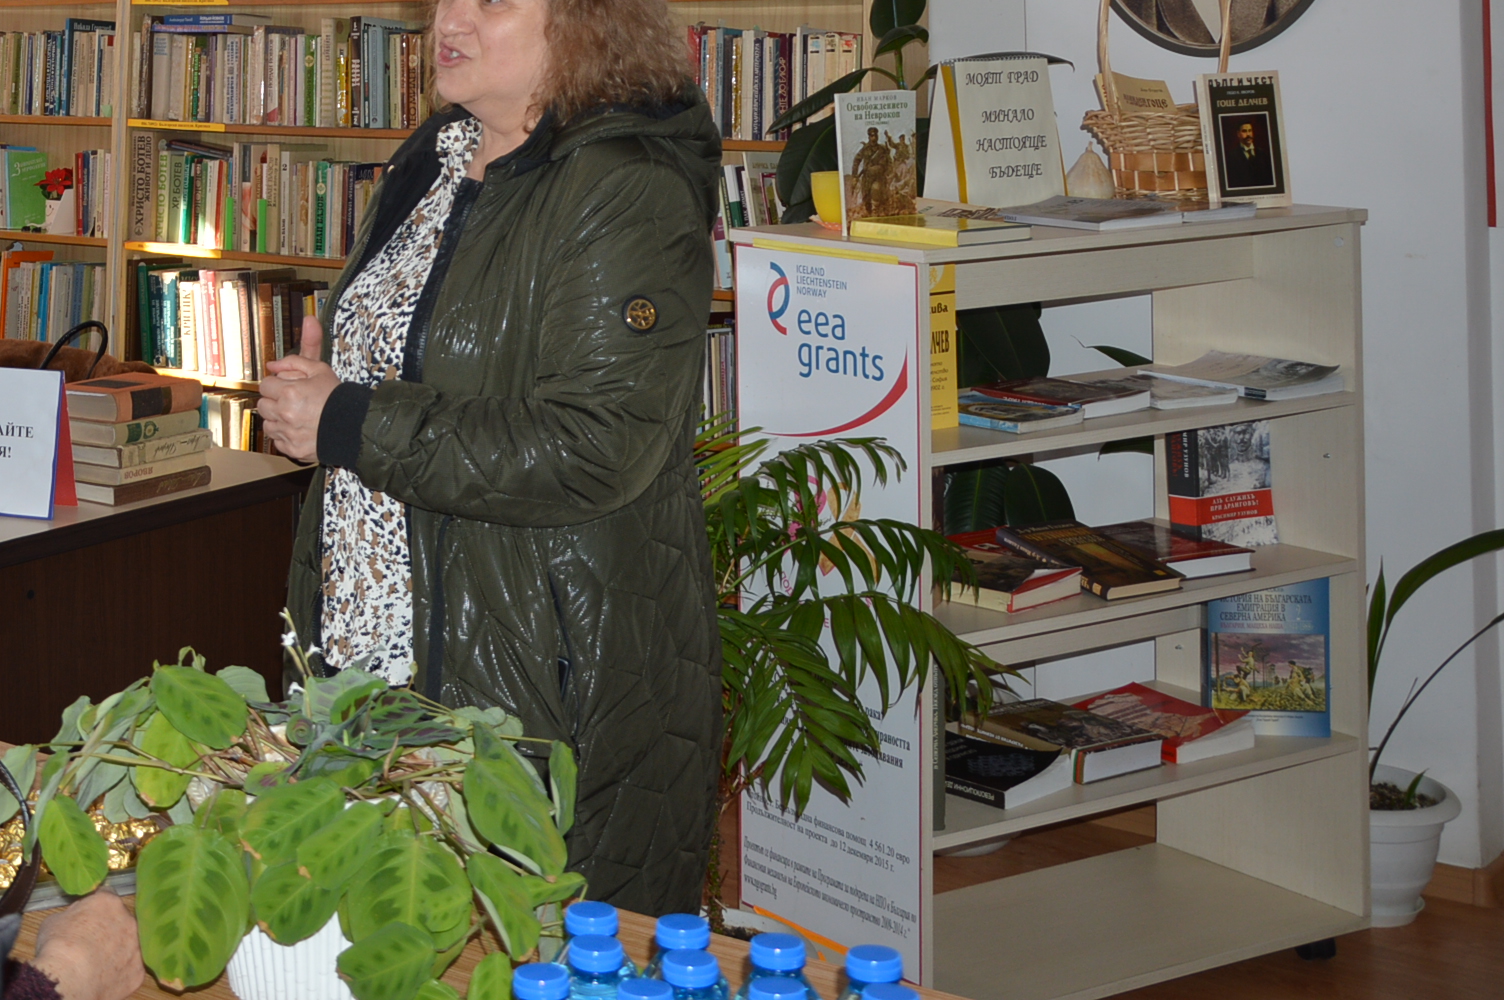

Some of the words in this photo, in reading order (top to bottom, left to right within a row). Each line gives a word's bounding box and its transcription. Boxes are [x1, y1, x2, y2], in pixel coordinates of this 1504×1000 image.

[965, 71, 1004, 87] МОЯТ
[1007, 70, 1039, 85] ГРАД
[1237, 77, 1244, 87] И
[846, 101, 908, 112] Освобождението
[1216, 99, 1236, 108] ГОЦЕ
[1238, 97, 1269, 107] ДЕЛЧЕВ
[864, 110, 901, 121] Неврокоп
[981, 108, 1035, 123] МИНАЛО
[976, 135, 1047, 153] НАСТОЯЩЕ
[136, 135, 146, 174] БОТЕВ
[158, 154, 167, 191] БОТЕВ
[172, 162, 182, 194] БОТЕВ
[988, 163, 1043, 179] БЪДЕЩЕ
[135, 177, 145, 227] ХРИСТО
[156, 193, 165, 238] ХРИСТО
[796, 264, 825, 277] ICELAND
[796, 275, 848, 290] LIECHTENSTEIN
[796, 286, 828, 298] NORWAY
[182, 289, 191, 336] КРИТИК
[930, 302, 949, 314] ива
[797, 308, 846, 341] eea
[930, 330, 950, 355] ЛЧЕВ
[797, 342, 885, 382] grants
[124, 466, 154, 480] ЯВОРОВ
[1254, 594, 1263, 602] НА
[1265, 594, 1312, 604] БЪЛГАРСКАТА
[1236, 603, 1278, 613] ЕМИГРАЦИЯ
[1281, 604, 1286, 612] В
[1219, 612, 1251, 621] СЕВЕРНА
[1252, 612, 1286, 622] АМЕРИКА
[746, 802, 796, 830] Продължителност
[797, 824, 803, 833] на
[805, 827, 828, 845] проекта
[830, 838, 838, 848] до
[839, 840, 847, 852] 12
[846, 846, 874, 863] декември
[874, 855, 889, 869] 2015
[814, 815, 845, 837] финансова
[846, 831, 867, 848] помощ
[874, 840, 895, 858] 561.20
[895, 851, 910, 865] евро
[875, 893, 887, 909] НПО
